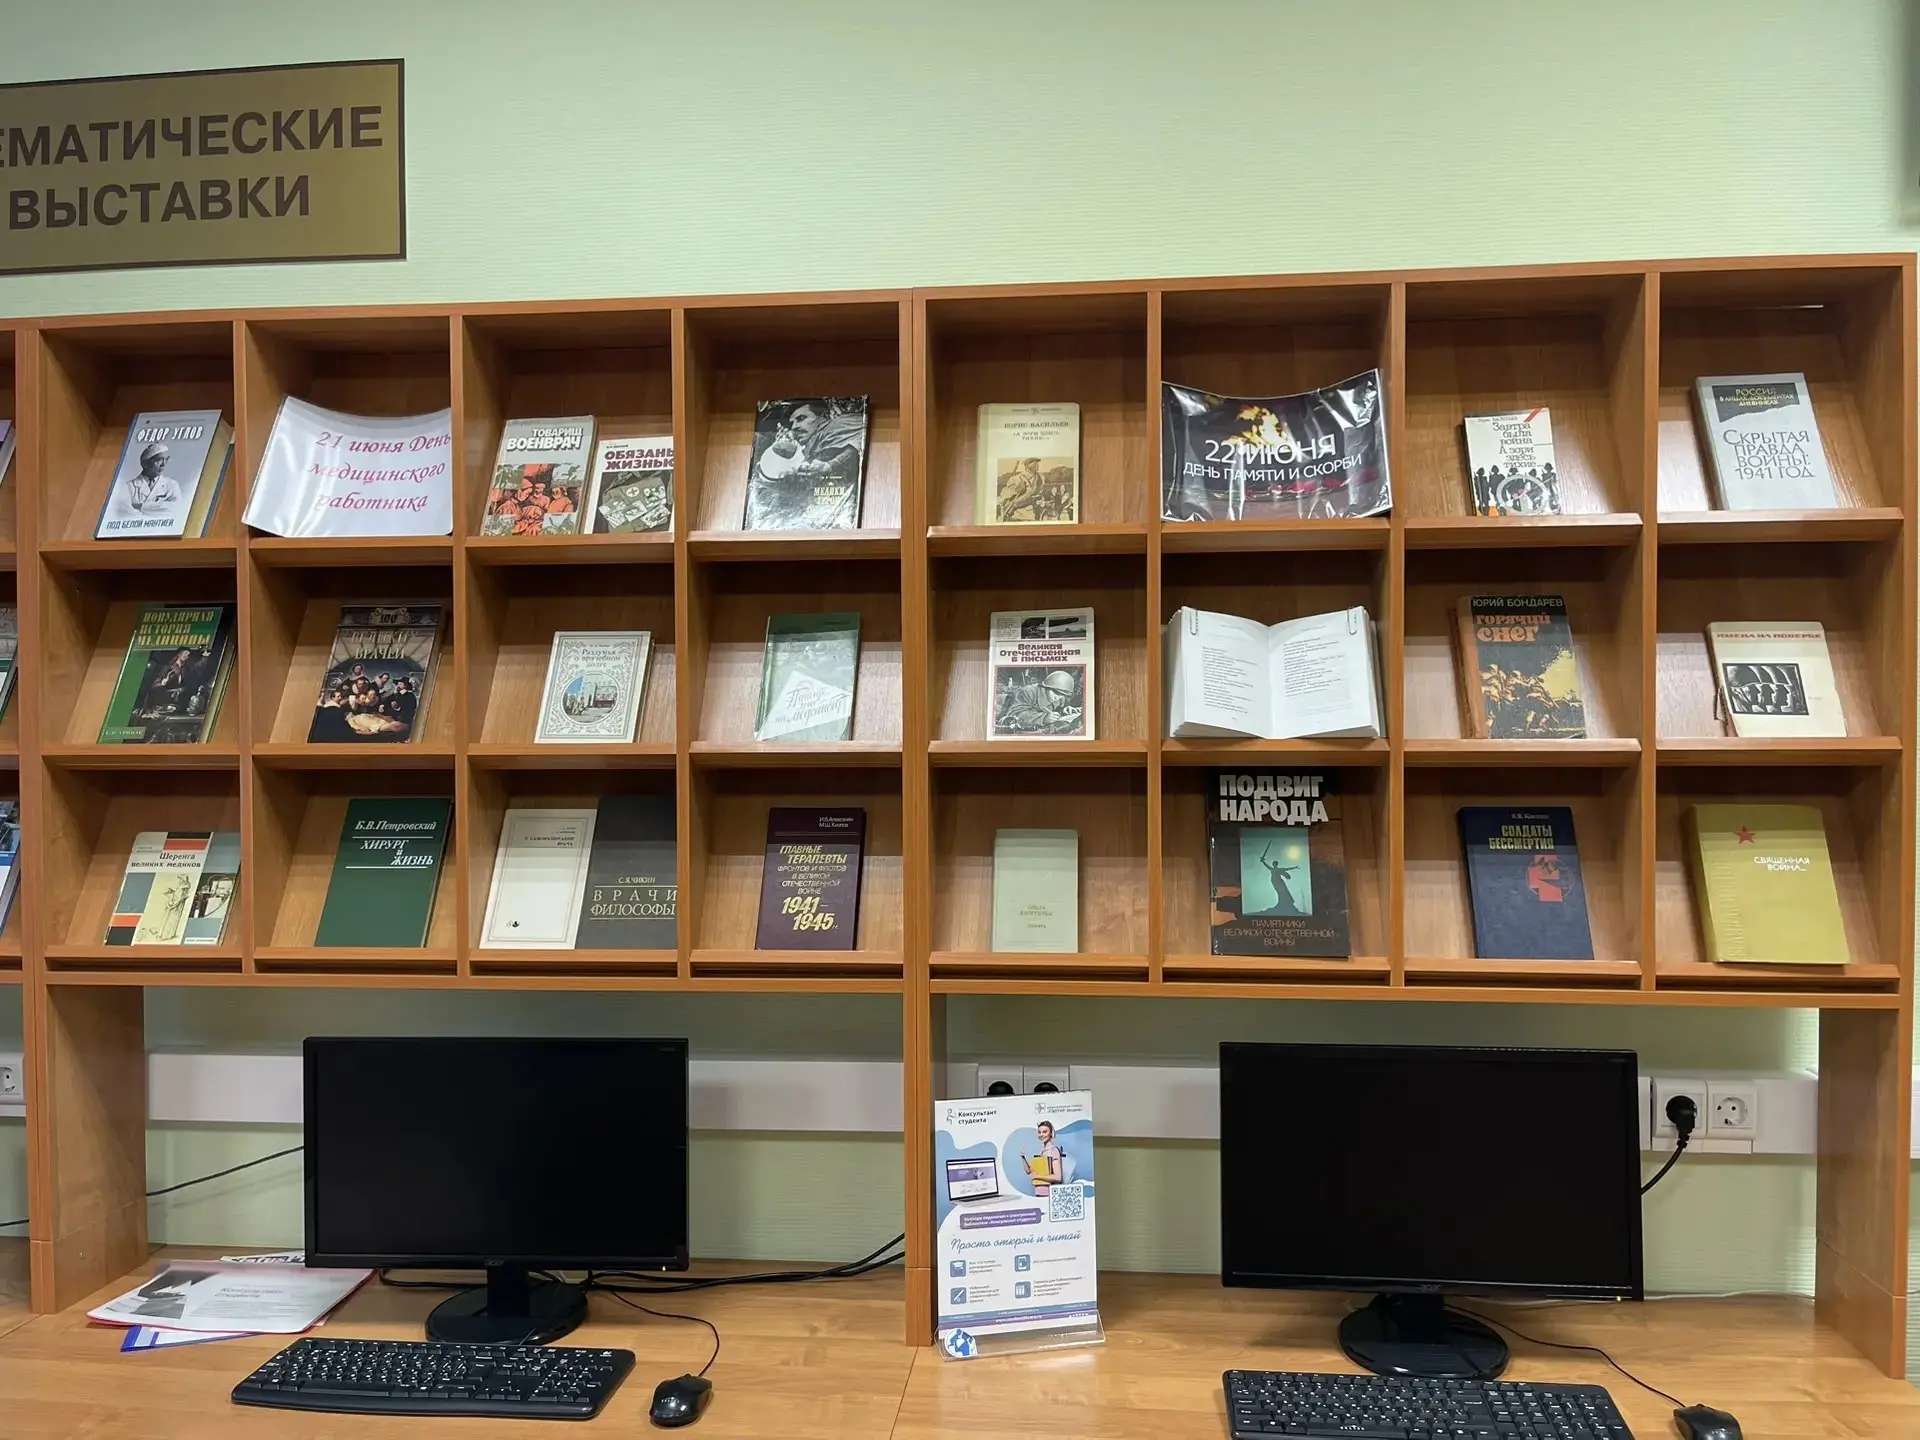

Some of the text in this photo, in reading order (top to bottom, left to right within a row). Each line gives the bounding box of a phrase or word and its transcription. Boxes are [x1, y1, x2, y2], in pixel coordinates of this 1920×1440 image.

[0, 106, 383, 168] МАТИЧЕСКИЕ
[9, 175, 310, 230] ВЫСТАВКИ
[1736, 388, 1777, 396] РОССИЯ
[532, 427, 584, 437] ТОВАРИЩ
[1492, 422, 1531, 432] Завтра
[137, 426, 204, 442] ФЕДОР УГЛОВ
[1502, 430, 1532, 438] была
[1723, 430, 1810, 445] СКРЫТАЯ
[316, 431, 451, 452] 21 июня День
[506, 436, 581, 451] ВОЕНВРАЧ
[1500, 437, 1533, 445] война
[1204, 434, 1336, 465] 22 ИЮНЯ
[1499, 446, 1534, 455] А зори
[1735, 443, 1805, 456] ПРАВДА
[1182, 453, 1363, 481] ДЕНЬ ПАМЯТИ И СКОРБИ
[1735, 466, 1815, 479] 1941 ГОД
[309, 462, 445, 484] медицинского
[314, 492, 428, 512] работника
[106, 519, 174, 530] ПОД БЕЛОЙ МАНТИЕЙ
[1473, 598, 1563, 607] ЮРИЙ БОНДАРЕВ
[143, 612, 214, 622] ПОПУЛЯРНАЯ
[140, 624, 192, 634] ИСТОРИЯ
[138, 634, 210, 646] МЕДИЦИНЫ
[355, 646, 405, 660] ВРАЧЕЙ
[1000, 649, 1081, 657] Отечественная
[1219, 775, 1323, 800] ПОДВИГ
[1220, 799, 1329, 826] НАРОДА
[355, 821, 438, 832] Б.В.Петровский
[1501, 824, 1553, 838] СОЛДАТЫ
[360, 840, 409, 850] ХИРУРГ
[1489, 838, 1554, 850] БЕССМЕРТИЯ
[780, 846, 823, 854] ГЛАВНЫЕ
[160, 852, 196, 860] Шеренга
[390, 856, 434, 866] ЖИЗНЬ
[787, 854, 848, 864] ТЕРАПЕВТЫ
[1754, 856, 1810, 865] СВЯЩЕННАЯ
[792, 872, 830, 880] В ВЕЛИКОЙ
[590, 903, 676, 916] ФИЛОСОФЫ
[1252, 920, 1306, 928] ПАМЯТНИКИ
[1223, 928, 1335, 938] ВЕЛИКОЙ ОТЕЧЕСТВЕННОЙ
[1264, 937, 1296, 946] ВОЙНЫ
[958, 1110, 997, 1118] Консультант
[951, 1237, 992, 1254] Просто
[993, 1233, 1034, 1248] открой
[1048, 1230, 1082, 1242] читай
